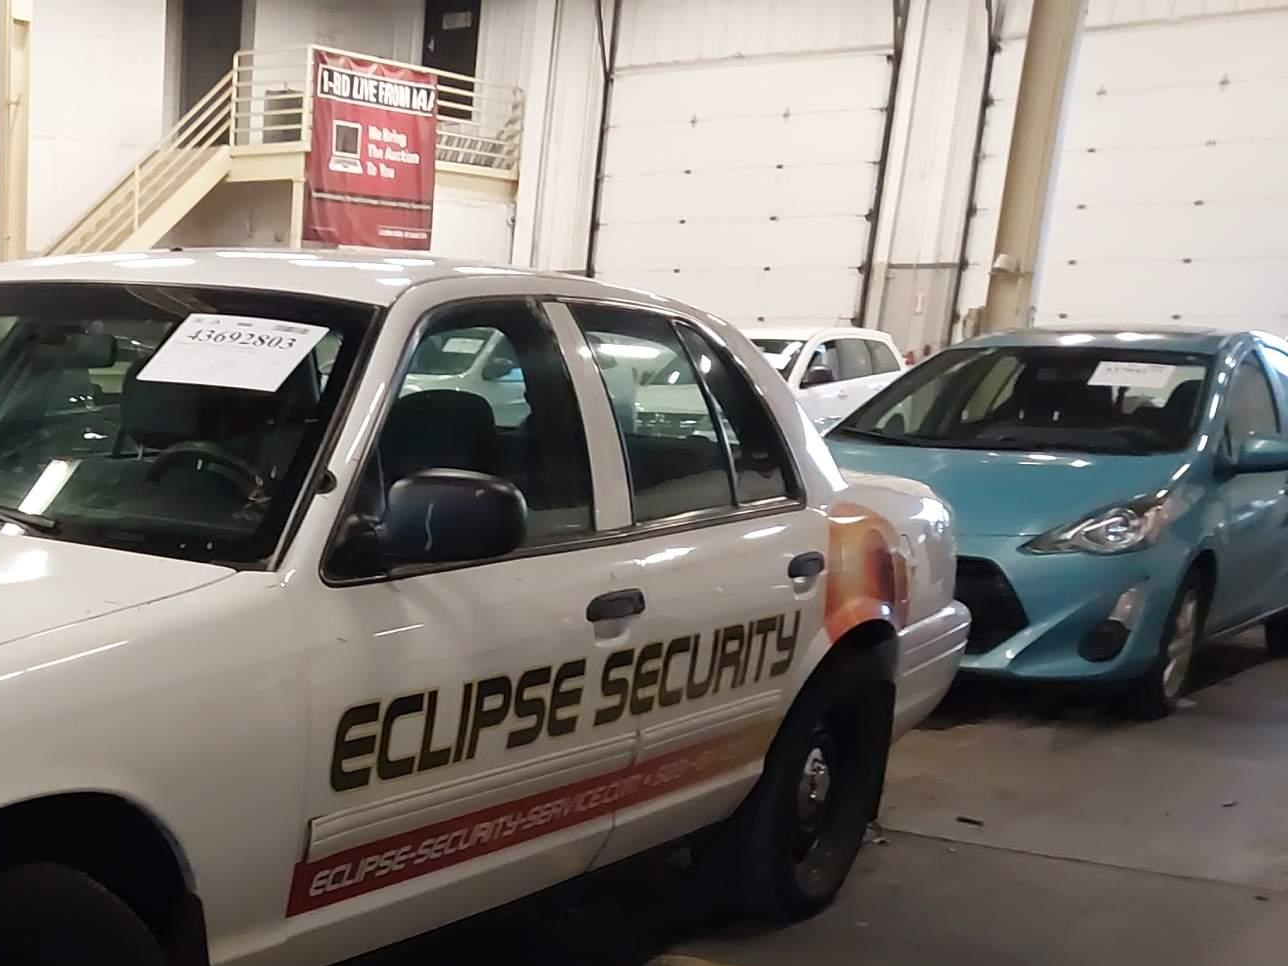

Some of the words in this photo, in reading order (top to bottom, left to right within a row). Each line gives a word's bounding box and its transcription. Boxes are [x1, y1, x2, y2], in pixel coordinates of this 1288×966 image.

[352, 76, 378, 102] LIVE
[378, 82, 411, 108] FROM
[186, 328, 298, 350] 43692803
[329, 658, 587, 793] ECLIPSE
[593, 610, 802, 727] SECURITY
